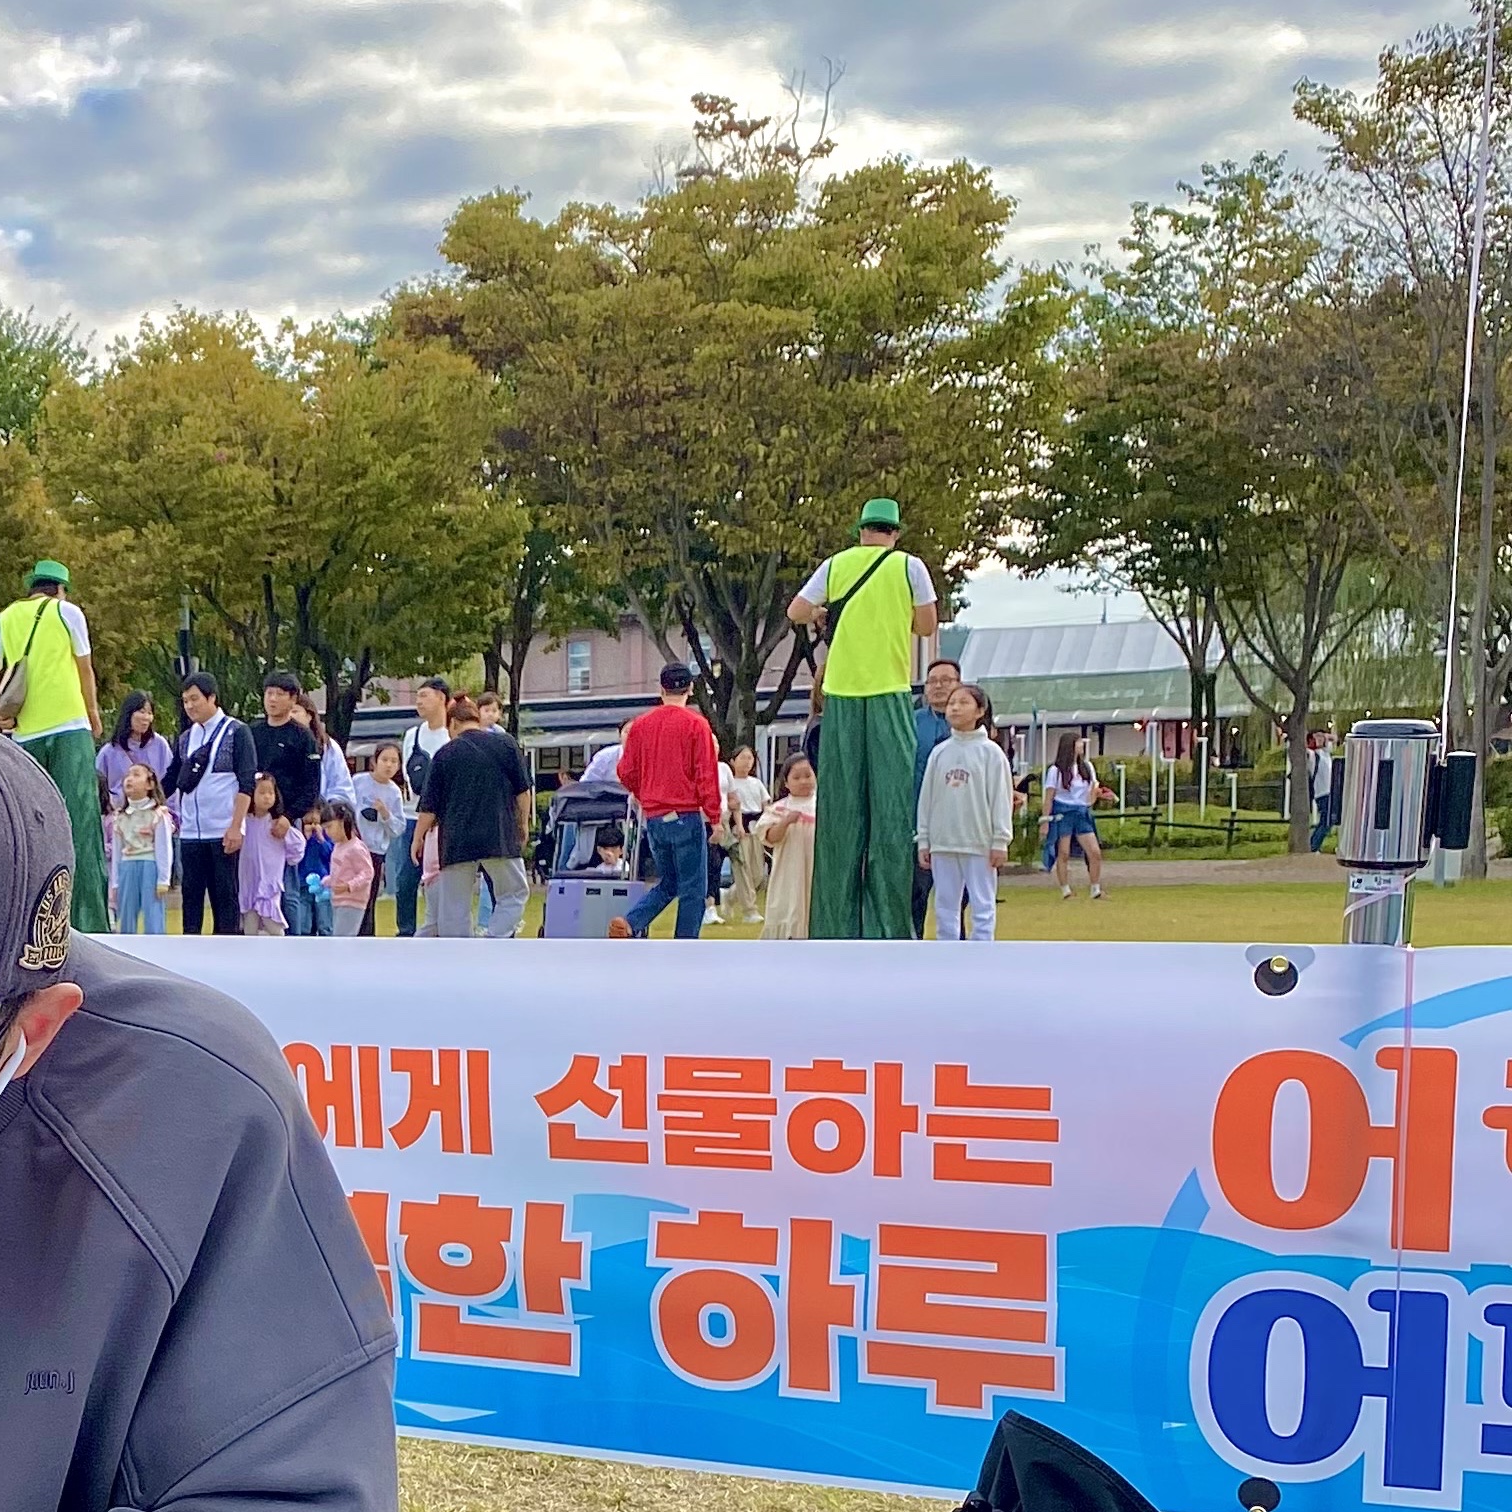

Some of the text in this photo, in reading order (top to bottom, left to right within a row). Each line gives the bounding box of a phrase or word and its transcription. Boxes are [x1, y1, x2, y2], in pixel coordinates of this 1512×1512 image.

[534, 1054, 1060, 1187] 선물하는
[1212, 1047, 1512, 1252] 어
[656, 1211, 1056, 1410] 하루
[1207, 1288, 1512, 1491] 어
